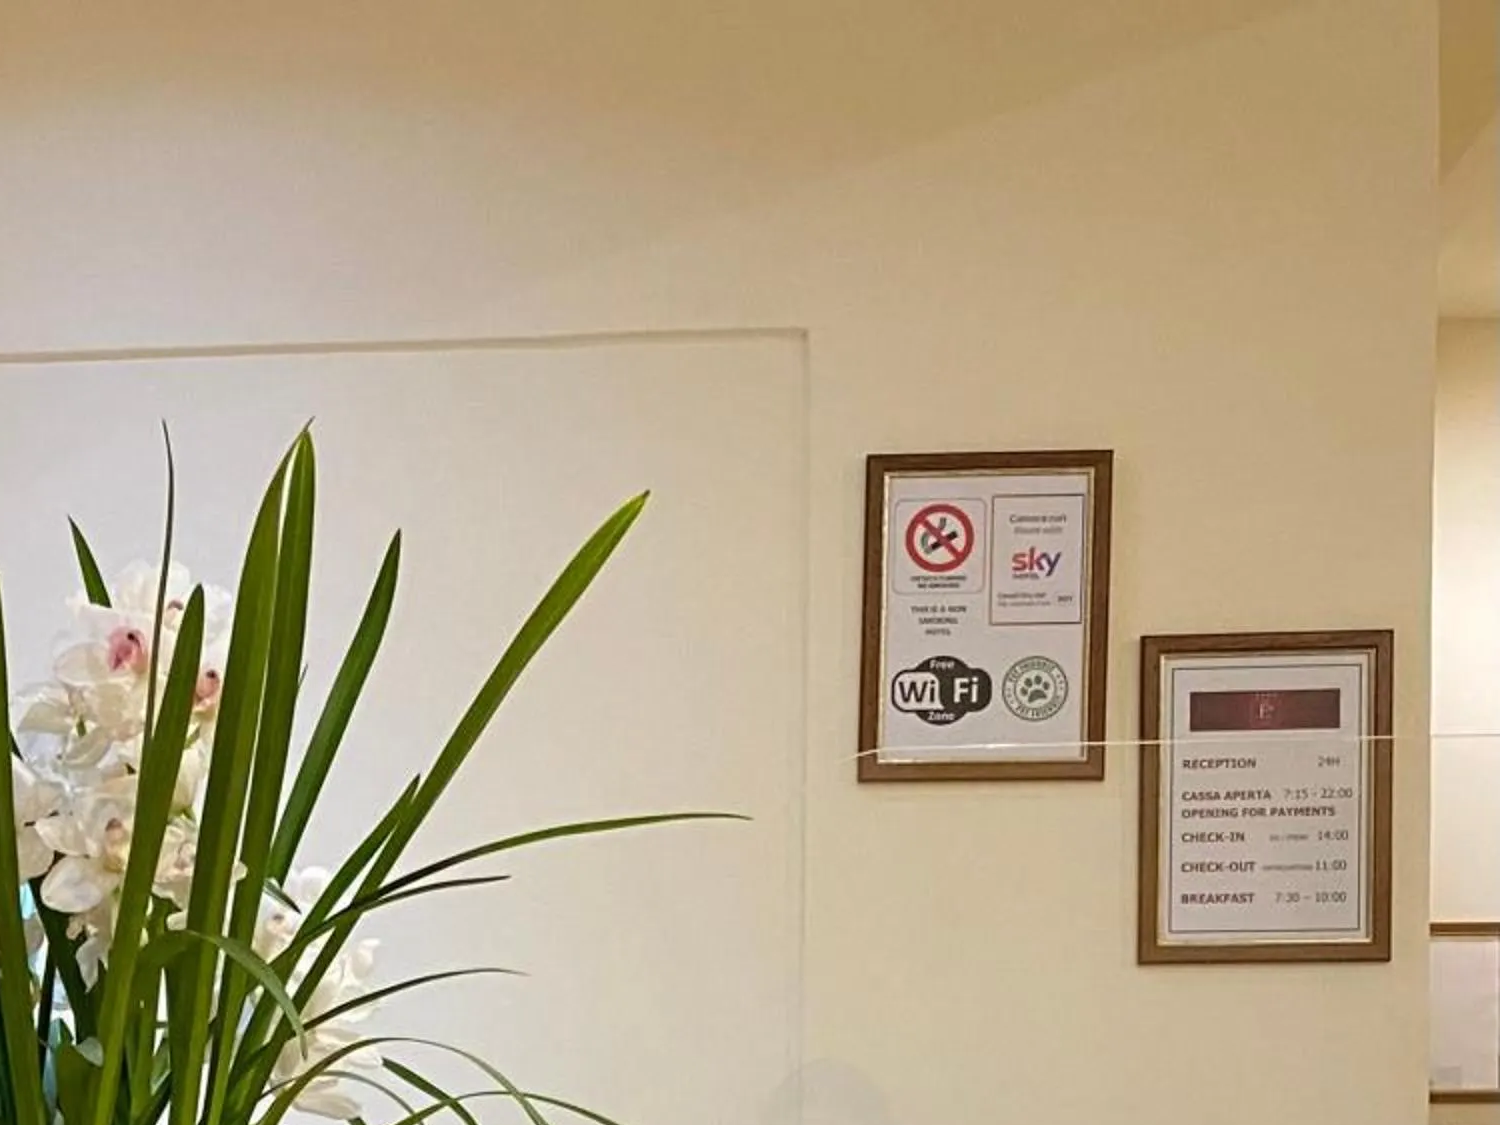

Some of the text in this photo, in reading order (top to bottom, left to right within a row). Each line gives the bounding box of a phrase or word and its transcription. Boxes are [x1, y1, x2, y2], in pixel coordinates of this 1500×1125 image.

[1011, 546, 1061, 577] sky
[1183, 757, 1257, 770] RECEPTION
[1182, 789, 1220, 802] CASSA
[1223, 788, 1272, 801] APERTA
[1320, 785, 1354, 799] 22:00
[1181, 804, 1336, 819] OPENING FOR PAYMENTS
[1181, 830, 1246, 843] CHECK-IN
[1318, 828, 1350, 841] 14:00
[1181, 860, 1257, 874] CHECK-OUT
[1315, 858, 1348, 872] 11:00
[1181, 891, 1256, 905] BREAKFAST
[1315, 890, 1348, 904] 10:00
